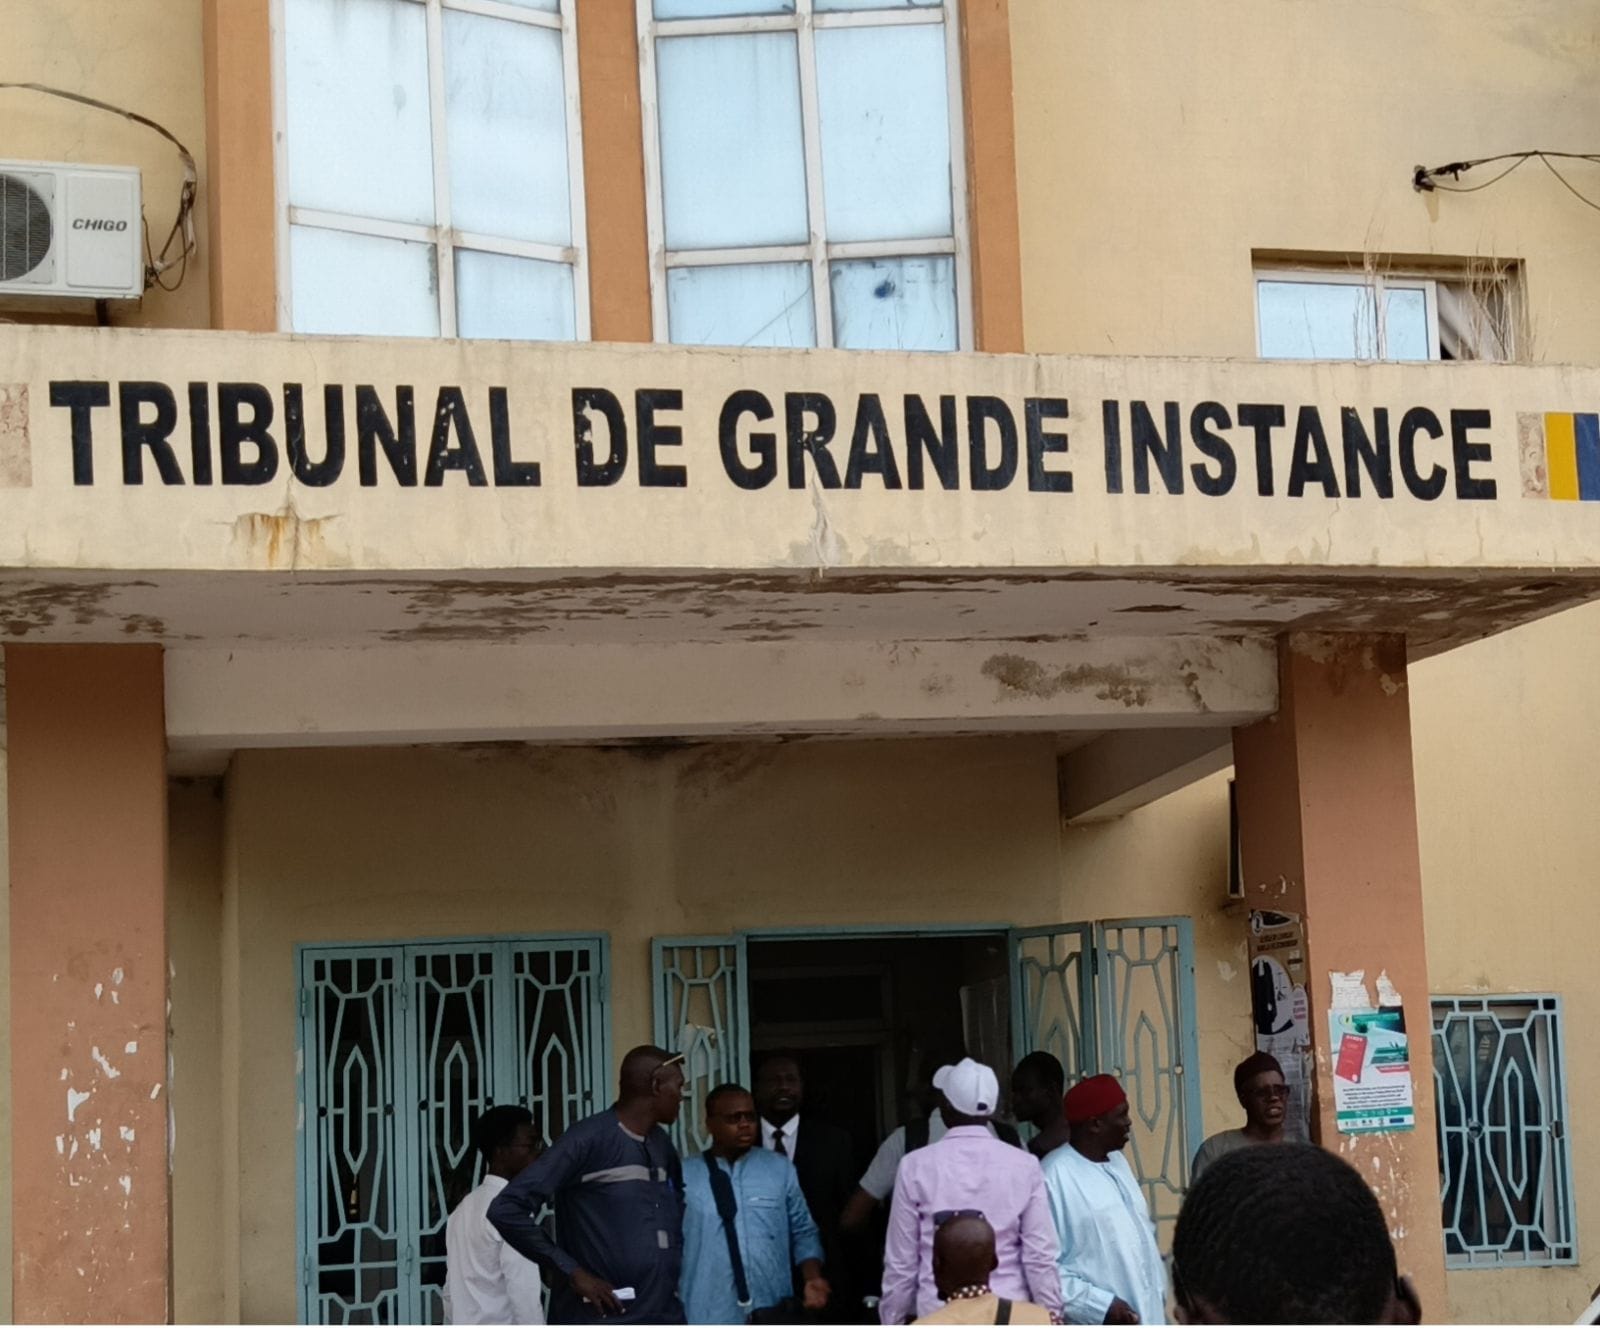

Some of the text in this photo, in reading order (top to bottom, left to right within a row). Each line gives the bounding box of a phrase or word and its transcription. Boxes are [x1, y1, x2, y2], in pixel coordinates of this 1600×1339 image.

[72, 218, 128, 232] CHIGO
[49, 380, 1497, 501] TRIBUNAL DE GRANDE INSTANCE
